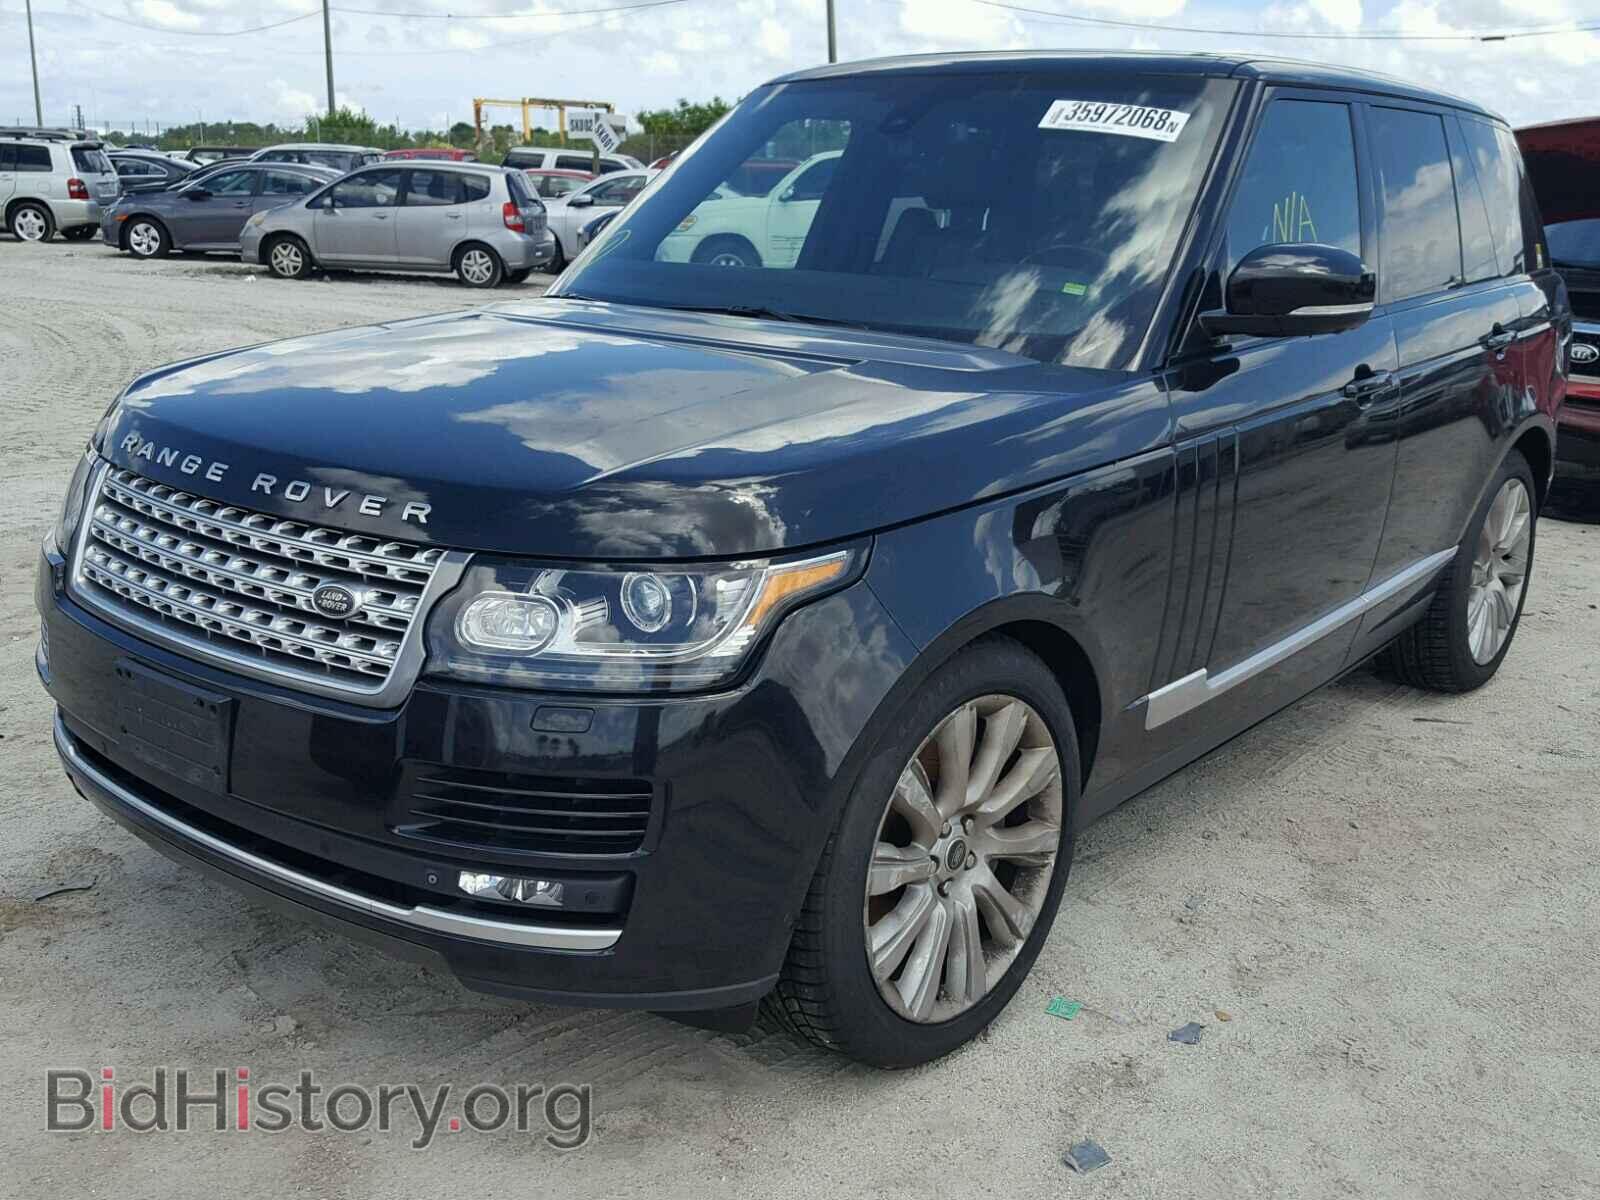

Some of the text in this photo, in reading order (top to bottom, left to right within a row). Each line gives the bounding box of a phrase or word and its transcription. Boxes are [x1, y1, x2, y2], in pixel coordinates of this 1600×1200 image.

[120, 432, 432, 524] RANGE ROVER
[321, 590, 343, 601] LAND
[321, 599, 348, 611] ROVER
